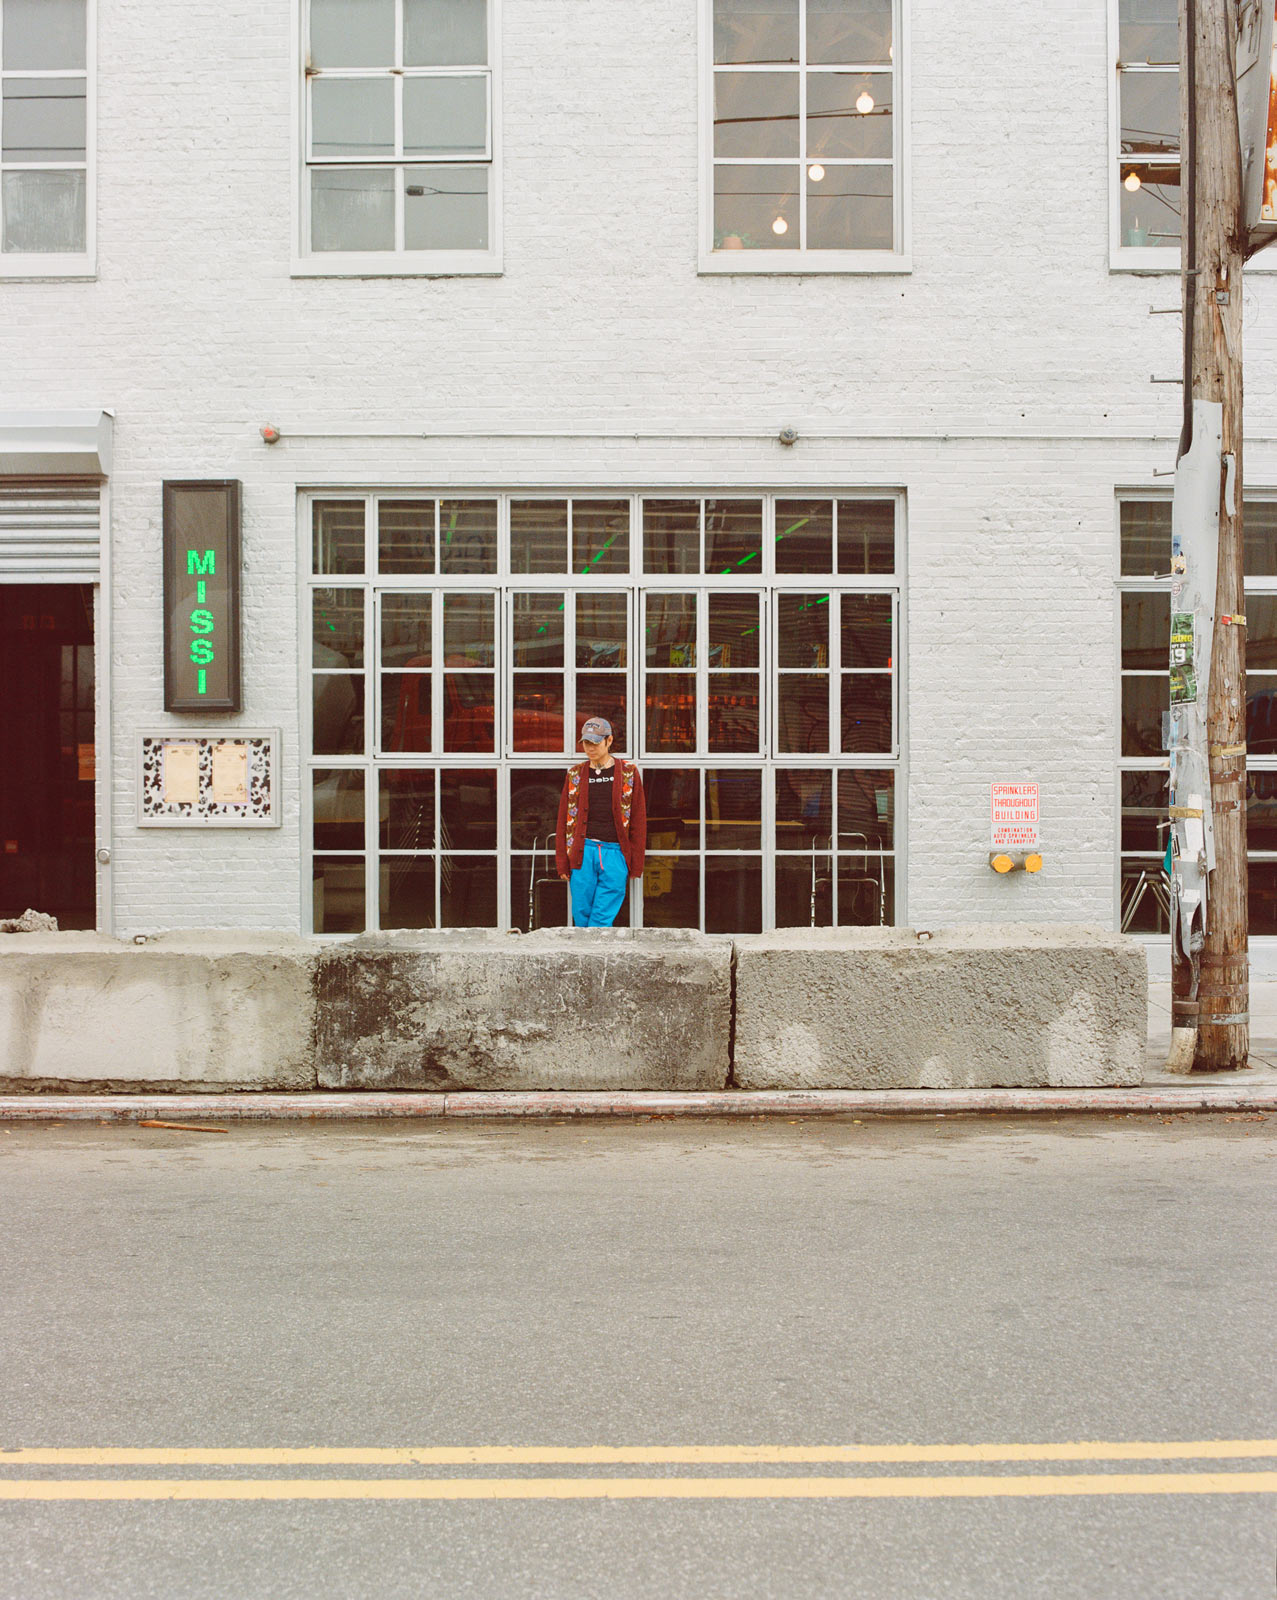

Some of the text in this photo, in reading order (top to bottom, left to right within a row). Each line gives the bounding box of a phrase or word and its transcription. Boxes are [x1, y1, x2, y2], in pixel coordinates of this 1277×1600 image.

[187, 549, 216, 694] MISSI
[588, 776, 615, 784] bebe
[993, 785, 1037, 795] SPRINKLERS
[993, 798, 1037, 808] THROUGHOUT
[995, 810, 1036, 820] BUILDING
